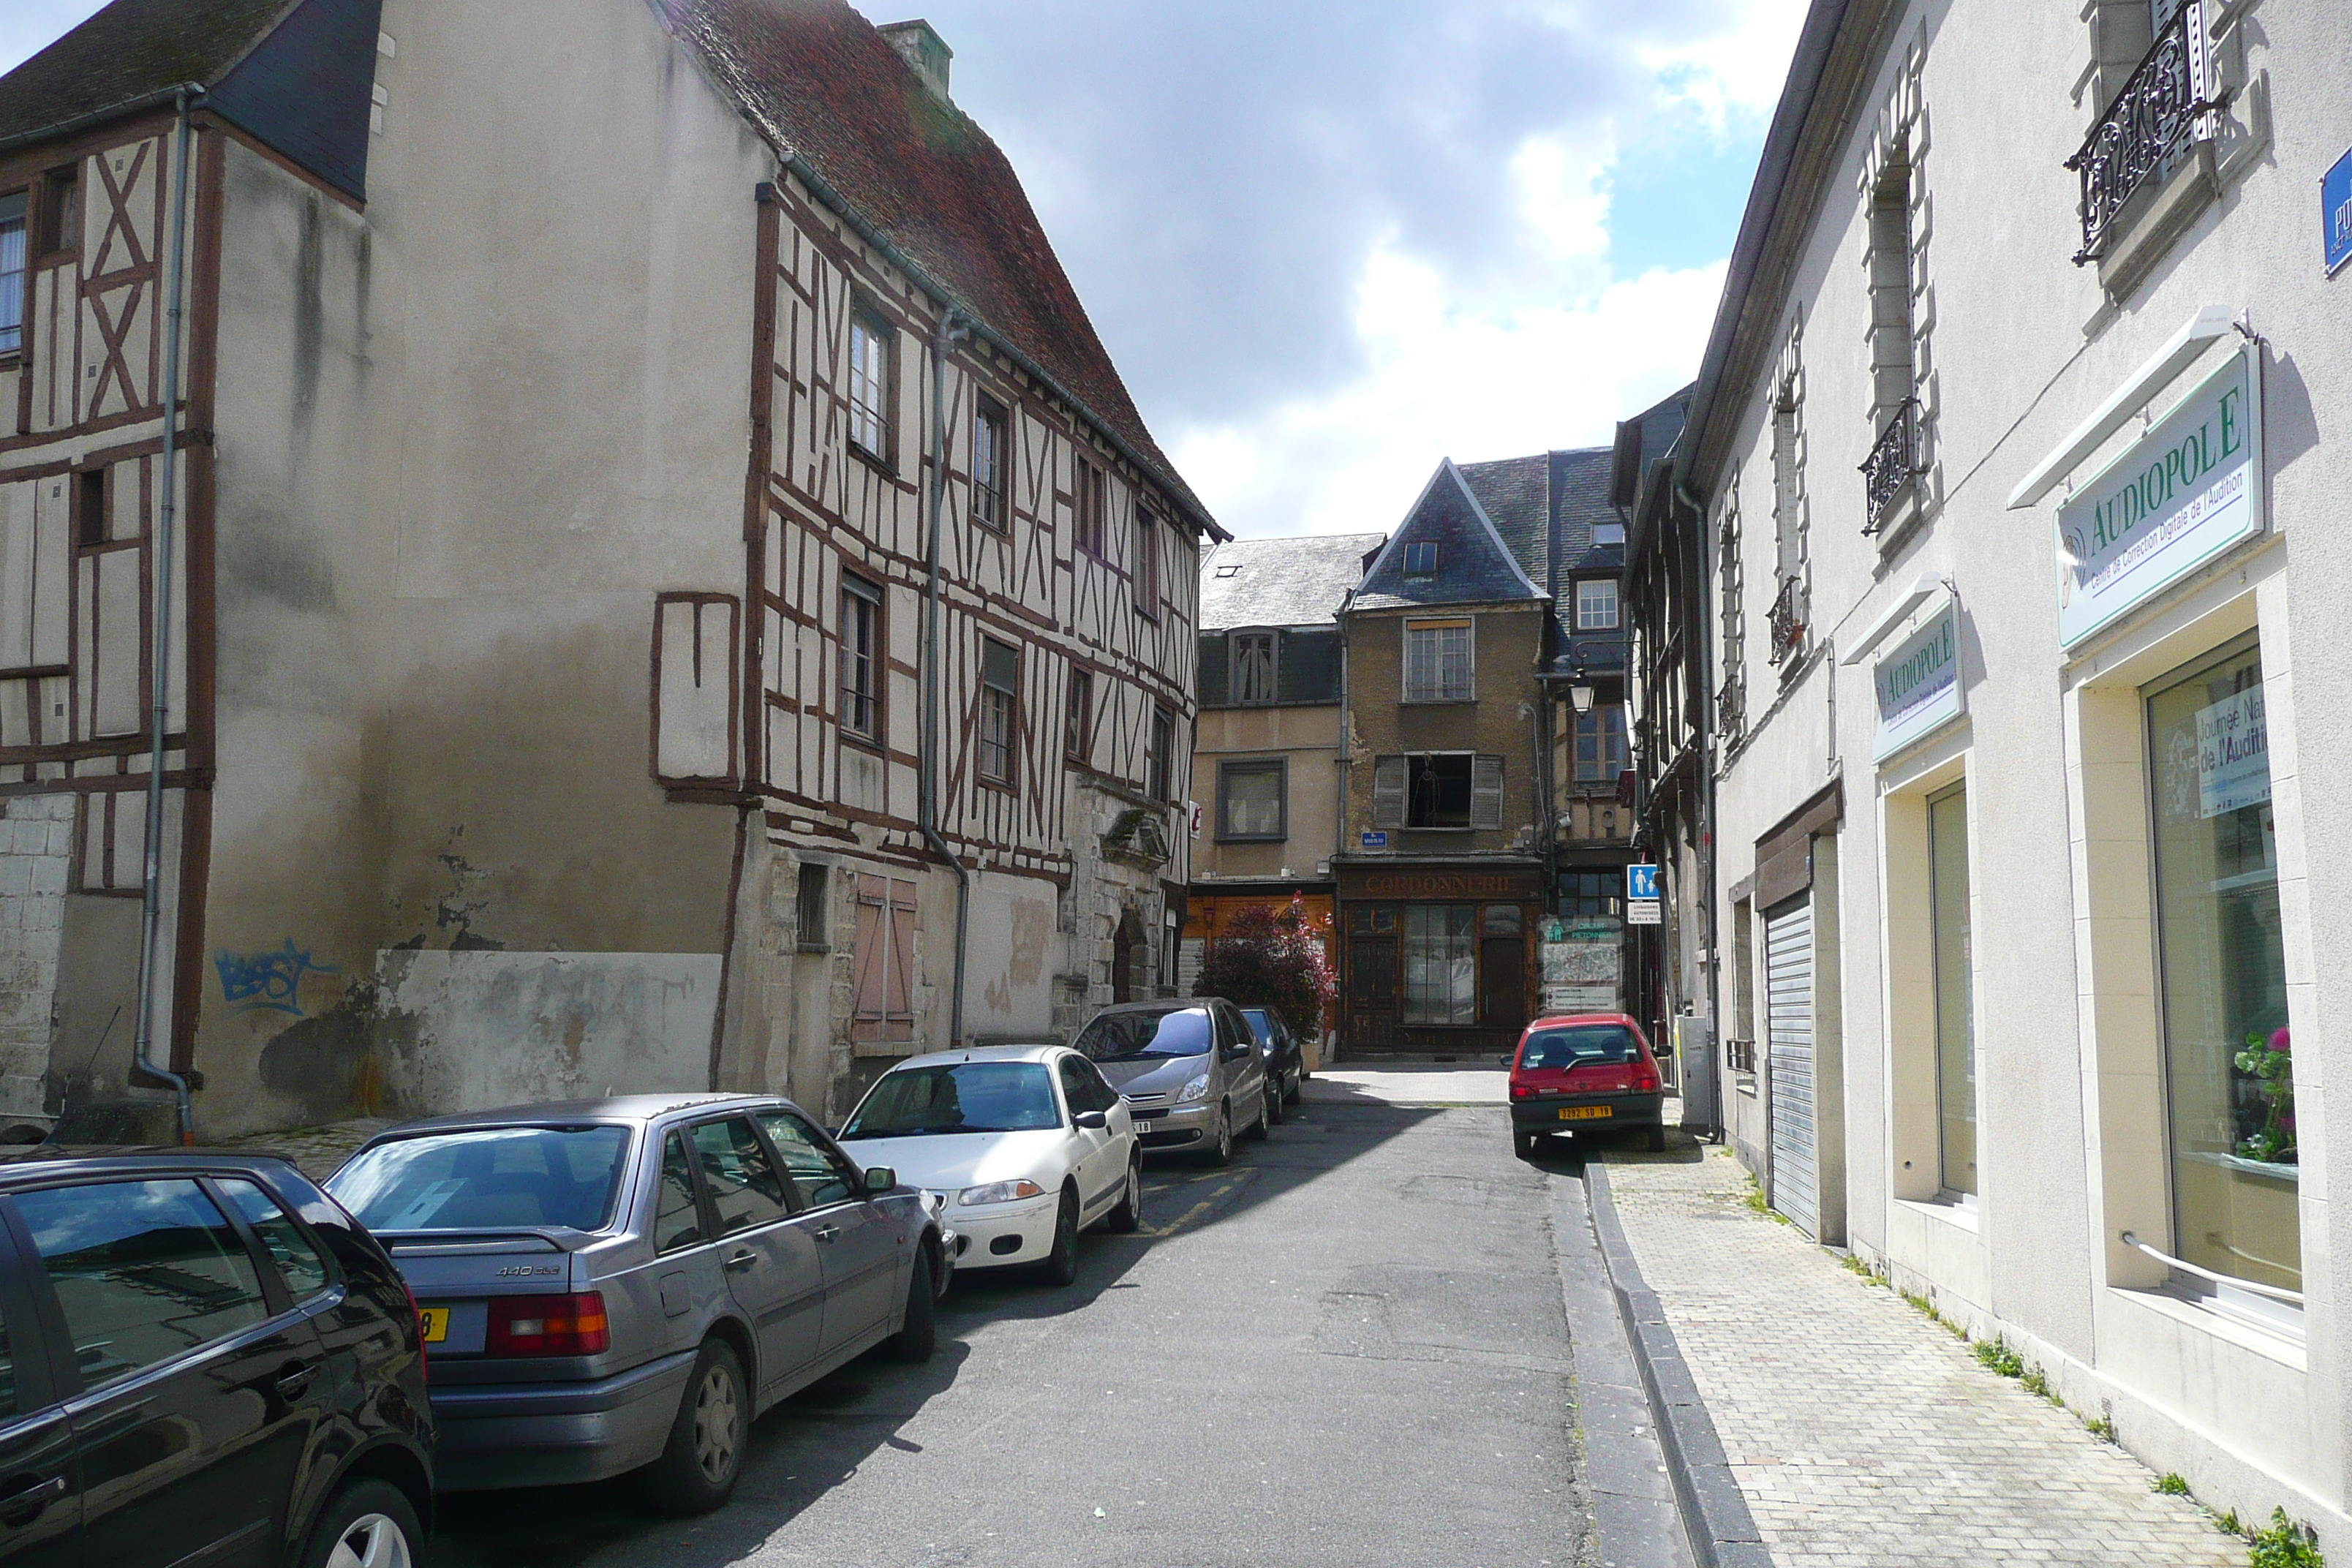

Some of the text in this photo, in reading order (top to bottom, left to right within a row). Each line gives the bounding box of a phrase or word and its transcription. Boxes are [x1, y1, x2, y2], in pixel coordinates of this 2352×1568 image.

[2091, 385, 2242, 557] AUDIOPOLE
[2091, 472, 2242, 589] Centre de Correction Digitale de l'Audition
[1888, 619, 1952, 706] AUDIOPOLE
[2199, 707, 2240, 742] Journée
[2201, 746, 2215, 773] de
[1139, 1122, 1149, 1132] 18
[1561, 1108, 1580, 1118] 3292
[1599, 1107, 1609, 1115] 18
[496, 1266, 560, 1277] 440 GLE
